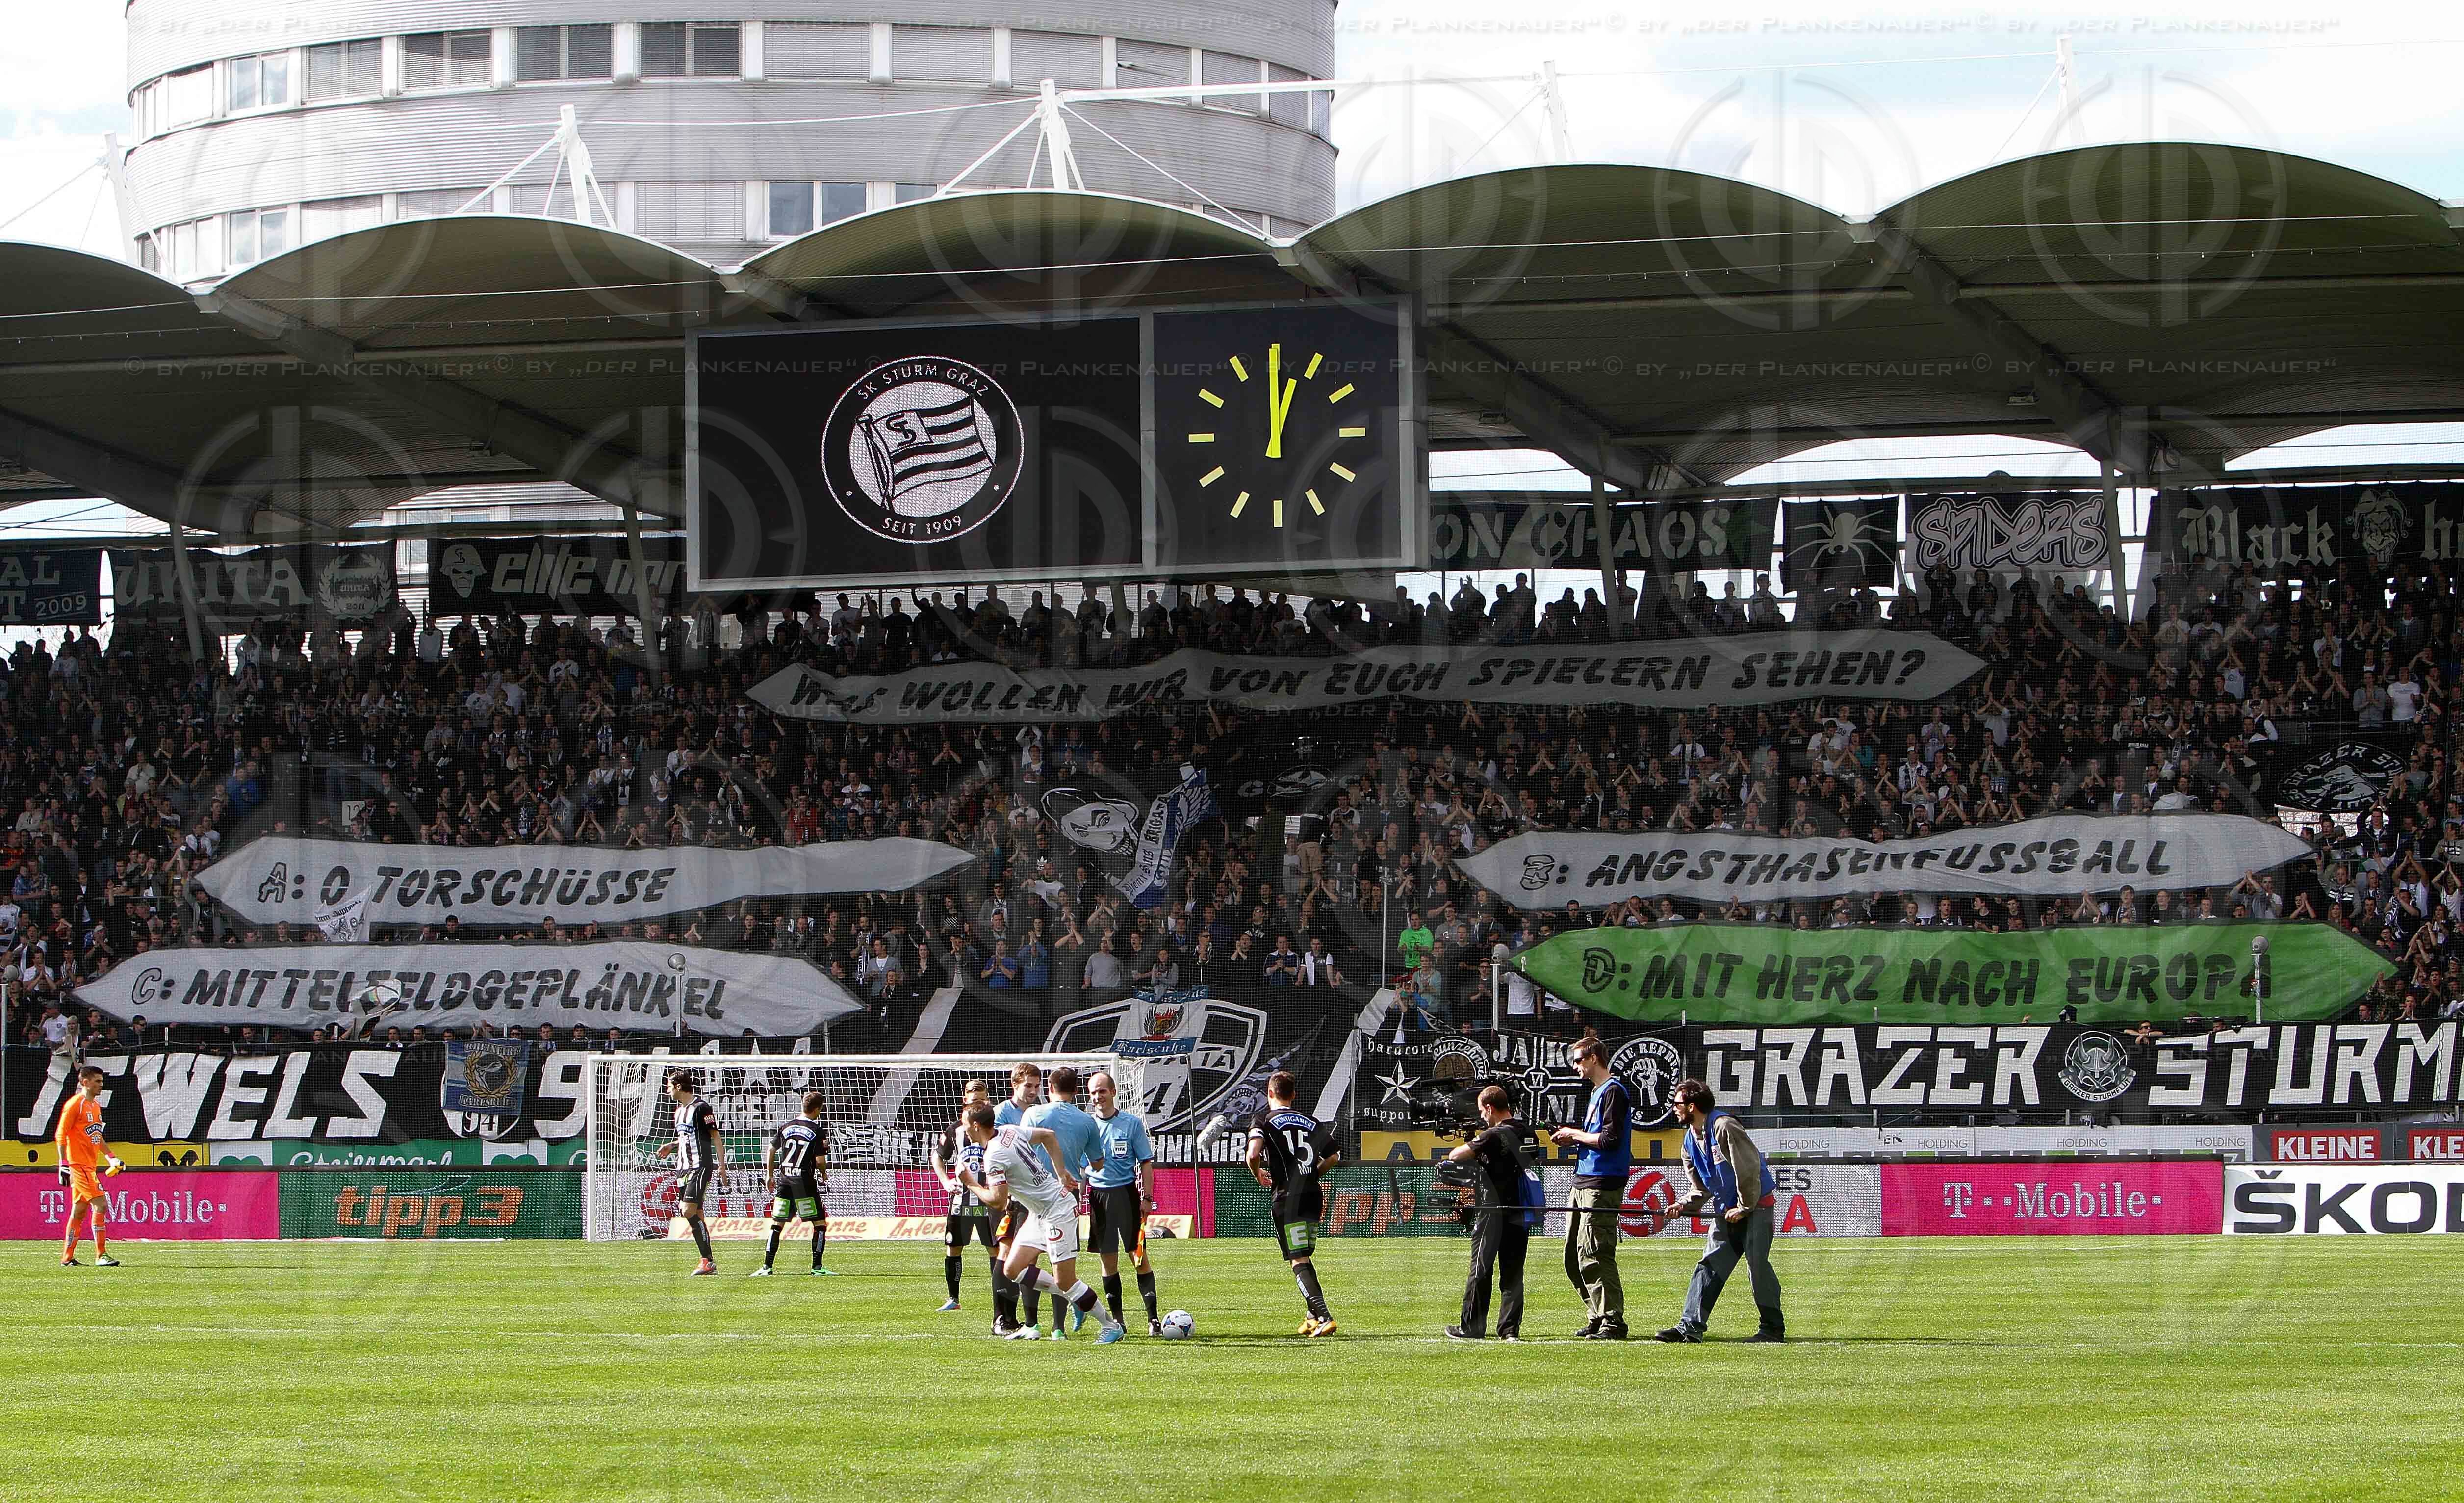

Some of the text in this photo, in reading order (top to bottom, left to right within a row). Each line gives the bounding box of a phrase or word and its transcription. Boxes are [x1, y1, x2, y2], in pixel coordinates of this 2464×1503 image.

[858, 364, 989, 400] SK STURM GRAZ
[882, 516, 962, 534] SEIT 1909
[1530, 508, 1731, 563] CHAOS
[2177, 505, 2338, 570] Black
[35, 595, 87, 617] 2009
[900, 680, 1087, 713] WOLLEN
[1208, 666, 1309, 695] VON
[1323, 662, 1451, 695] EUCH
[1468, 656, 1711, 691] SPIELERN
[1731, 649, 1926, 689] SEHEN?
[371, 865, 676, 908] TORSCHÜSSE
[131, 967, 175, 1005] C:
[1639, 953, 1743, 999] MIT
[1757, 954, 1886, 1004] HERZ
[1902, 957, 2039, 1007] NACH
[1614, 1047, 1636, 1071] DIE
[1638, 1043, 1680, 1110] REPRESSION
[1703, 1023, 2464, 1107] GRAZER STURM
[2063, 1079, 2130, 1101] GRAZER STURMFLUT
[1273, 1115, 1314, 1128] PUNTIGAMER
[782, 1138, 810, 1168] 27
[1283, 1130, 1313, 1166] 15
[1779, 1139, 1830, 1150] HOLDING
[1917, 1139, 1968, 1150] HOLDING
[2057, 1138, 2107, 1148] HOLDING
[2195, 1137, 2246, 1147] HOLDING
[2277, 1136, 2375, 1160] KLEINE
[784, 1168, 802, 1177] KLEM
